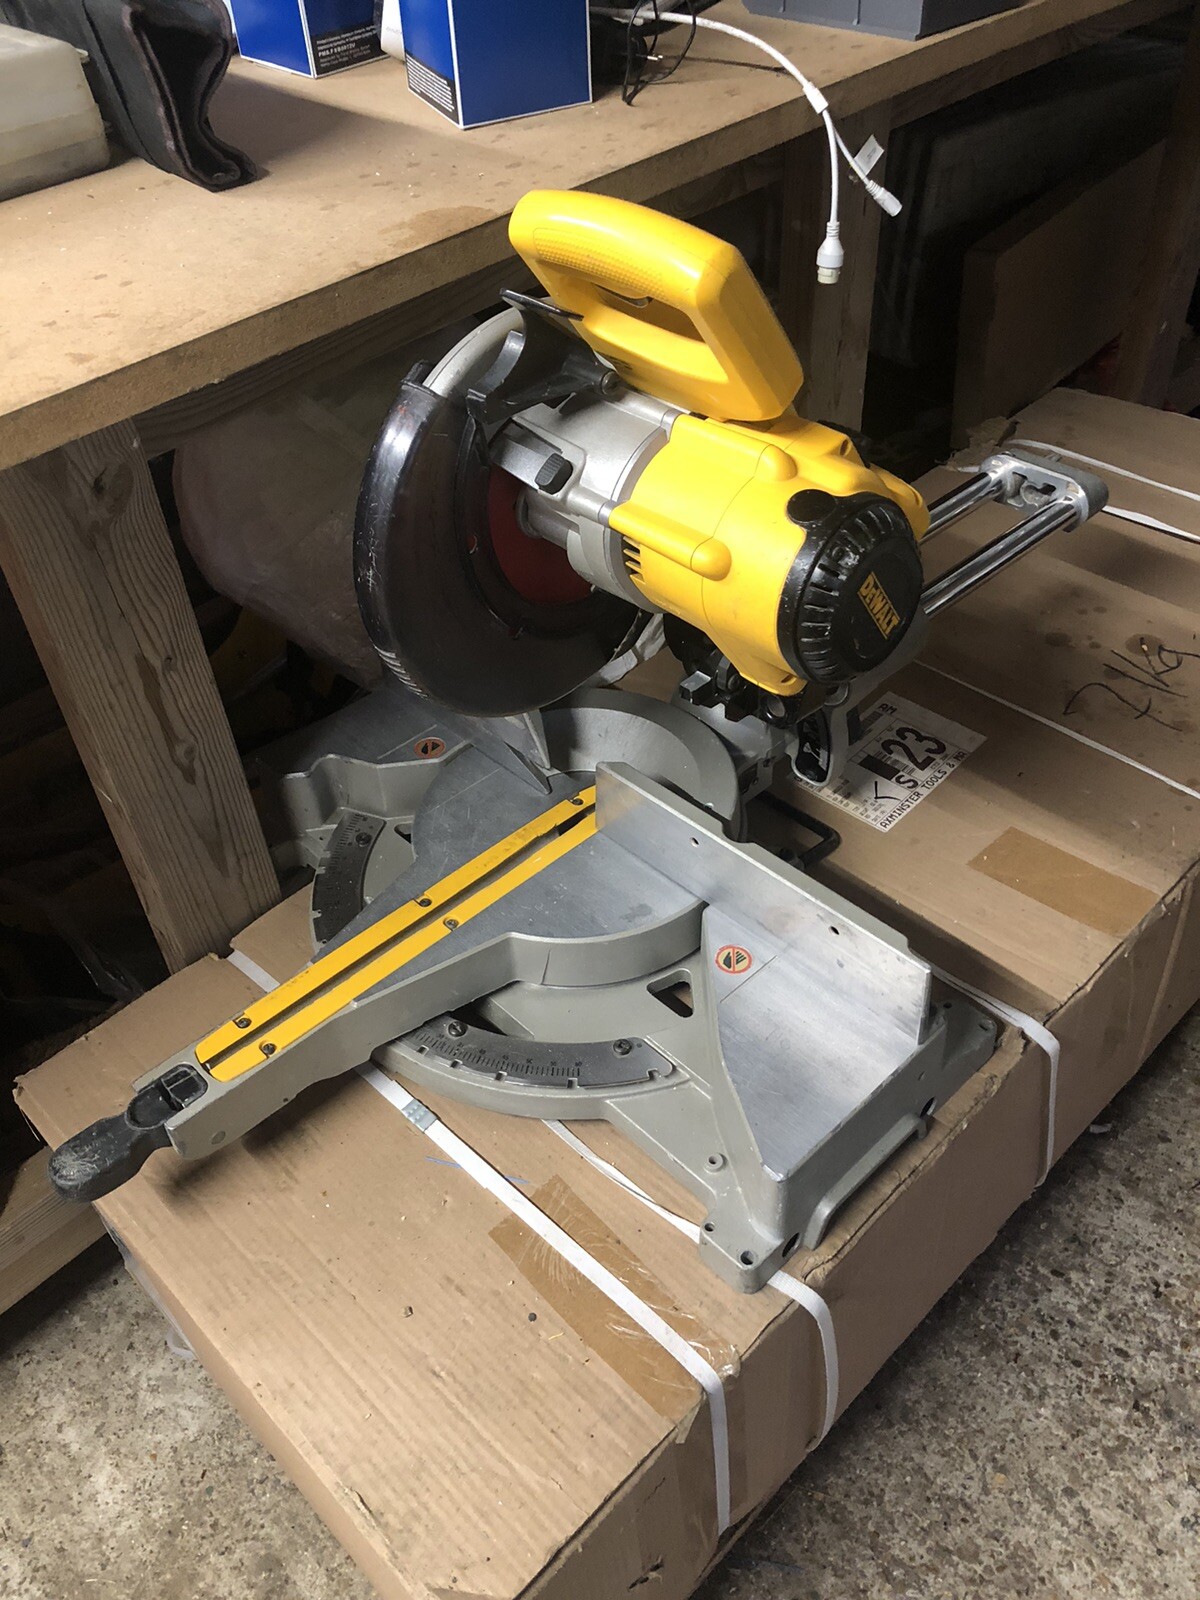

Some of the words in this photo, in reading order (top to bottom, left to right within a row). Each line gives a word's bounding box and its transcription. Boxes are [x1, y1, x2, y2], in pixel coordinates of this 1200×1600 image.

[859, 573, 899, 635] DEWALT
[881, 727, 946, 772] 23
[880, 791, 923, 829] AXMINSTER
[921, 769, 947, 790] TOOLS
[895, 774, 919, 789] S
